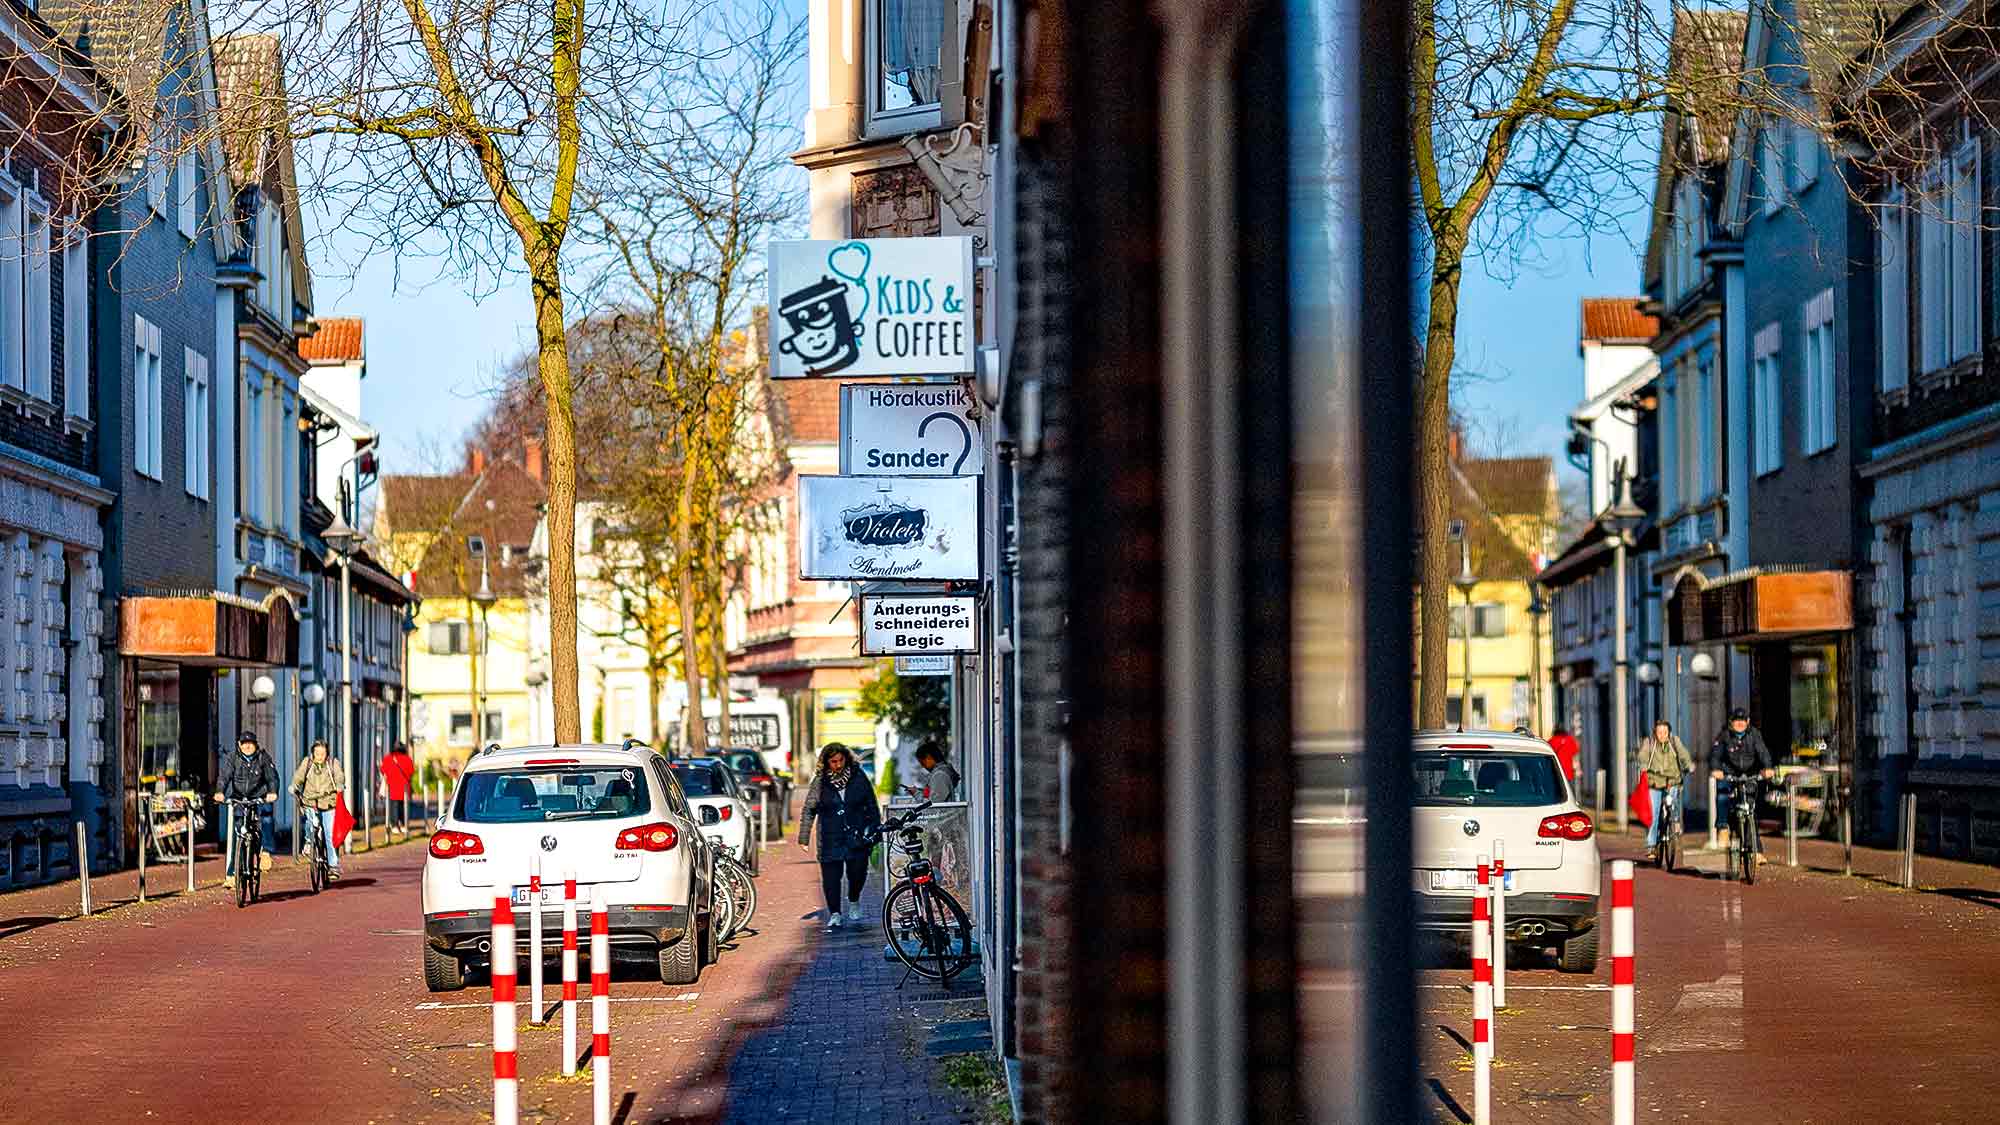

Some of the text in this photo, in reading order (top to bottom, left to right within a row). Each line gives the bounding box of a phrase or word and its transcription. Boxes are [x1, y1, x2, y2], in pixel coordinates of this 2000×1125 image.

[877, 275, 964, 315] KIDS &
[876, 318, 965, 357] COFFEE
[869, 390, 968, 407] Hörakustik
[867, 449, 950, 468] Sander
[849, 556, 923, 576] Abendmode
[873, 601, 966, 617] Änderungs-
[874, 617, 970, 630] schneiderei
[895, 634, 945, 649] Begic
